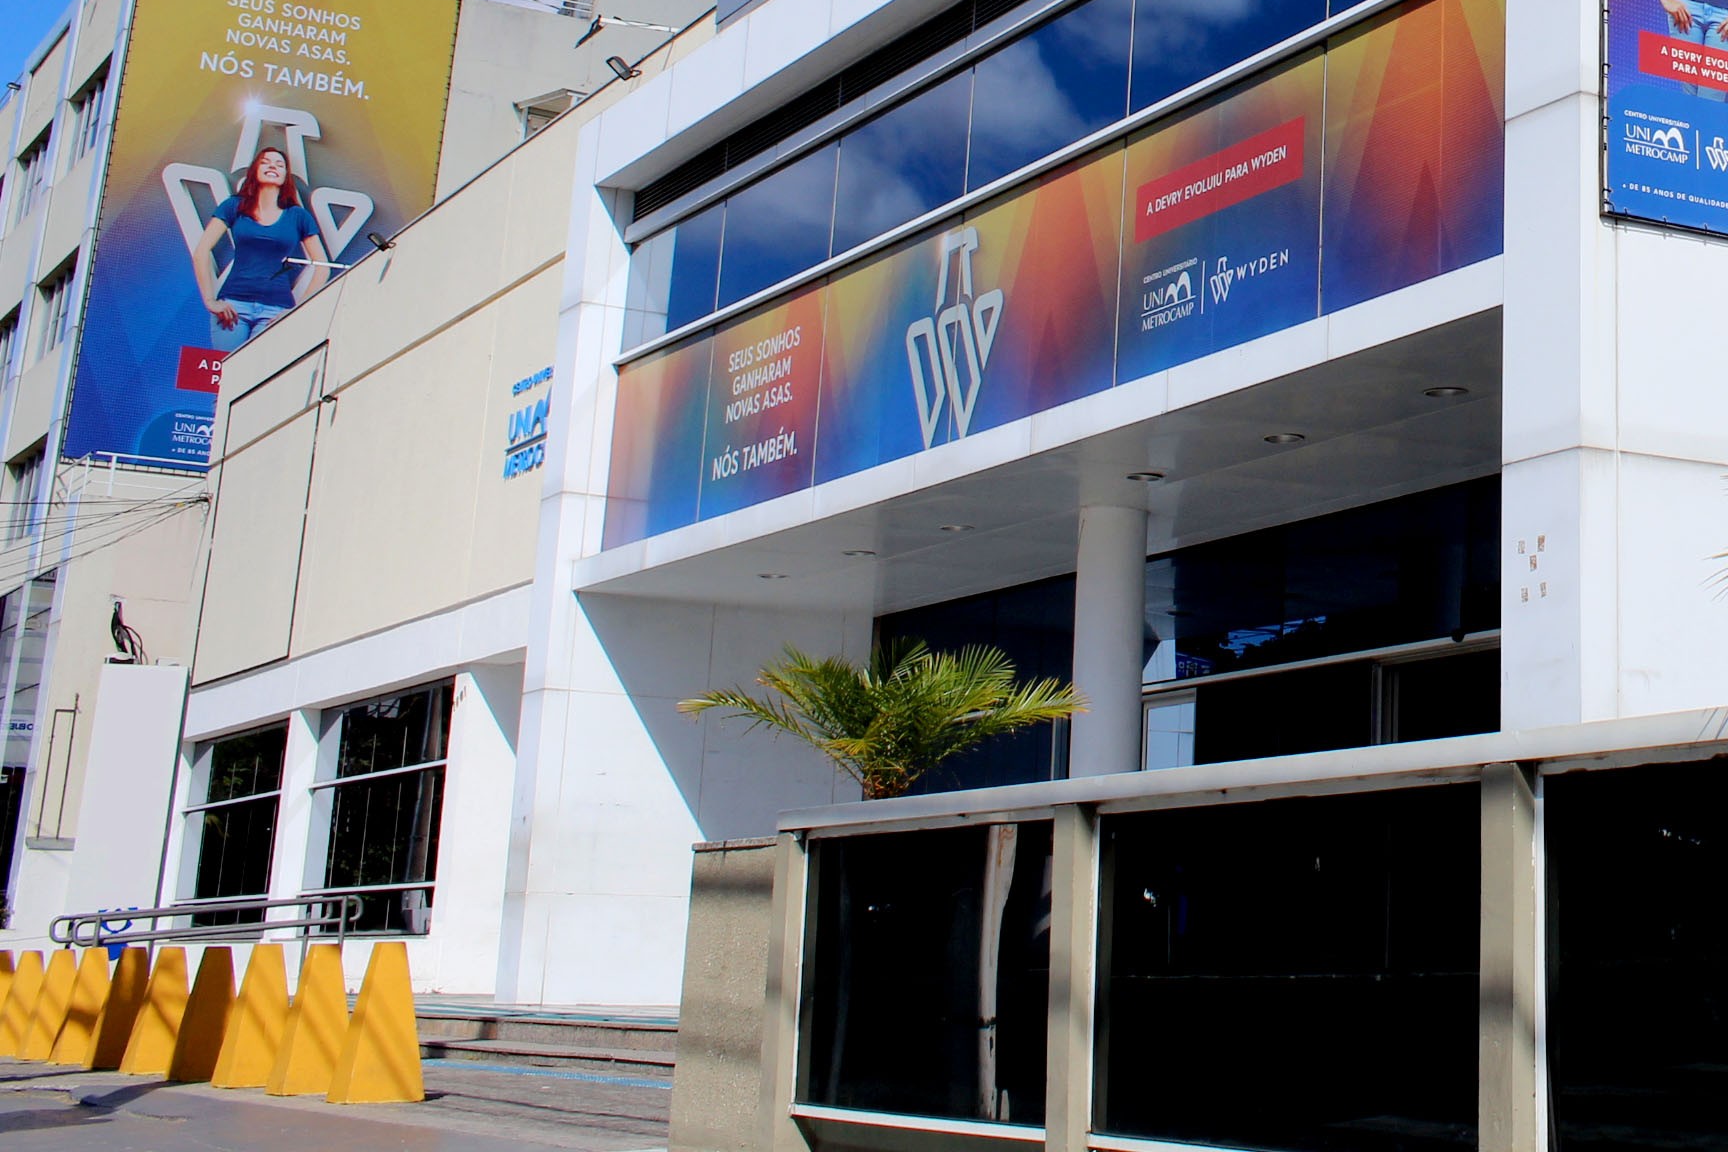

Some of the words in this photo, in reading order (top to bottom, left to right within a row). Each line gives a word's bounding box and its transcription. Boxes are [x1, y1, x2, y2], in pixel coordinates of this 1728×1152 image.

[238, 13, 347, 46] GANHARAM
[281, 3, 361, 30] SONHOS
[226, 29, 291, 54] NOVAS
[297, 43, 351, 65] ASAS.
[1661, 46, 1668, 55] A
[1671, 48, 1702, 64] DEVRY
[200, 50, 255, 78] NÓS
[263, 63, 370, 100] TAMBÉM.
[1672, 61, 1698, 76] PARA
[1626, 123, 1650, 141] UNI
[1625, 143, 1688, 164] METROCAMP
[1146, 203, 1153, 216] A
[1155, 188, 1183, 212] DEVRY
[1184, 174, 1222, 199] EVOLUIU
[1225, 164, 1249, 184] PARA
[1251, 145, 1287, 171] WYDEN
[1629, 182, 1639, 191] DE
[1653, 188, 1674, 198] ANOS
[1676, 192, 1686, 201] DE
[1236, 249, 1289, 281] WYDEN
[1143, 287, 1163, 310] UNI
[1142, 302, 1194, 332] METROCAMP
[728, 350, 753, 373] SEUS
[756, 326, 801, 364] SONHOS
[198, 359, 208, 370] A
[732, 356, 792, 395] GANHARAM
[211, 375, 221, 385] P
[725, 397, 760, 424] NOVAS
[762, 383, 793, 411] ASAS.
[174, 421, 196, 433] UNI
[712, 444, 738, 481] NÓS
[742, 426, 798, 472] TAMBÉM.
